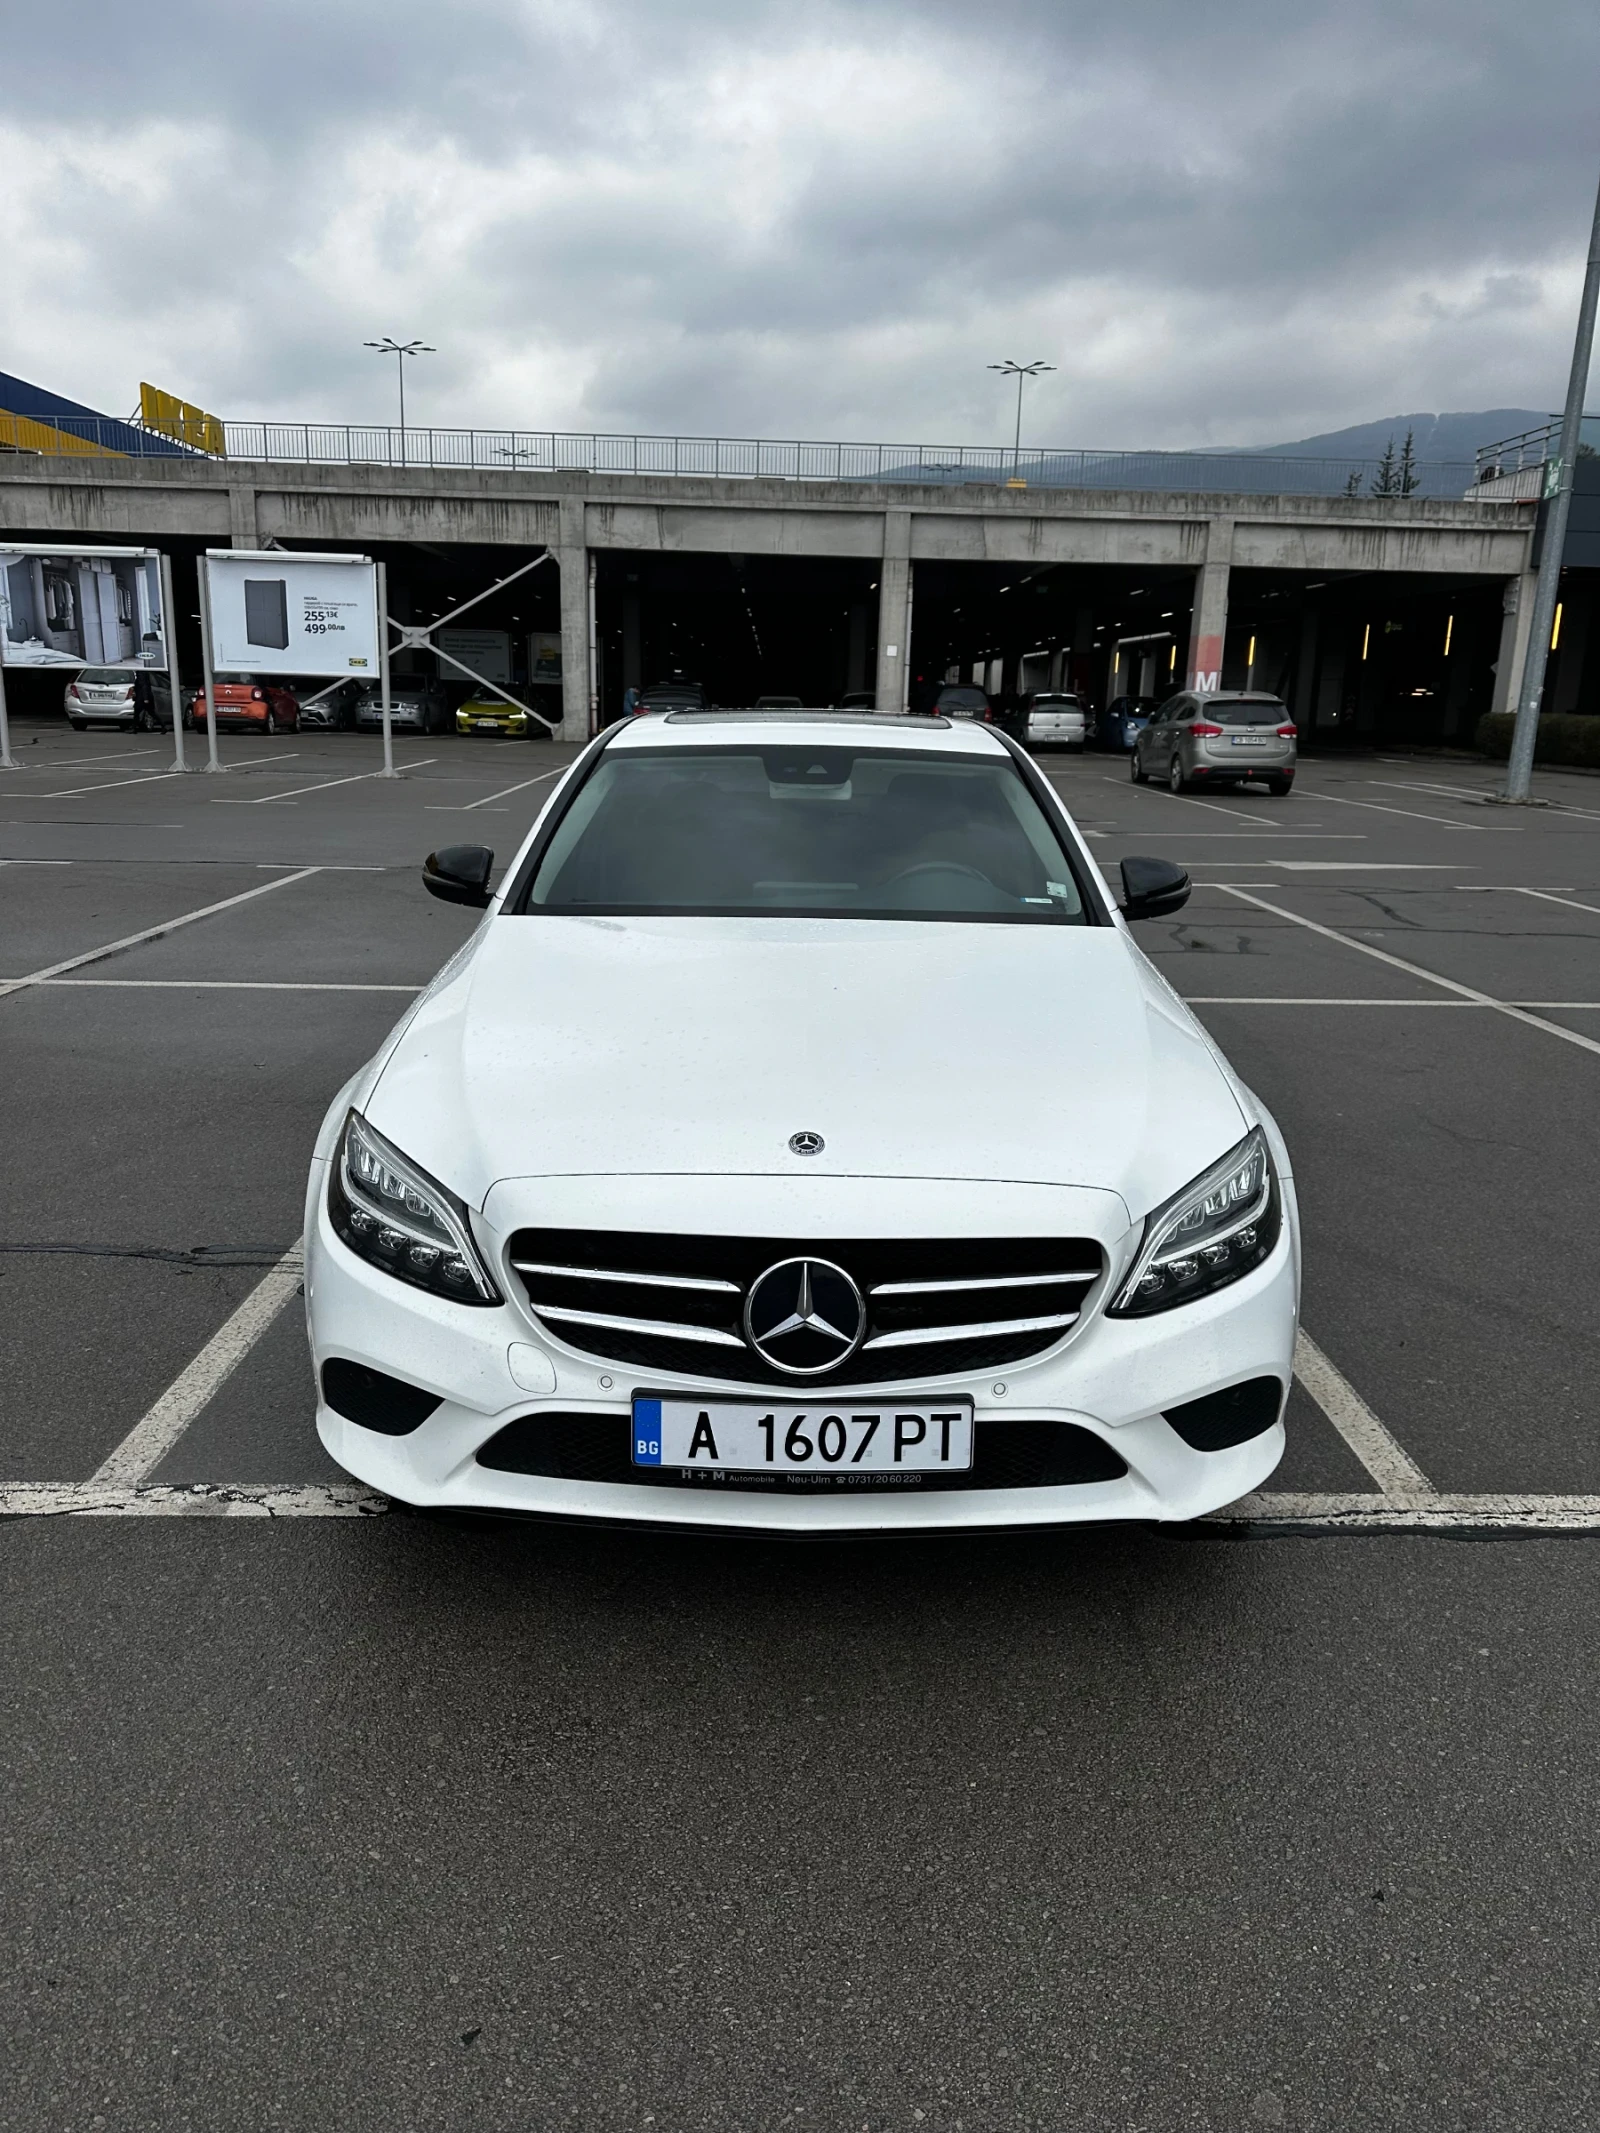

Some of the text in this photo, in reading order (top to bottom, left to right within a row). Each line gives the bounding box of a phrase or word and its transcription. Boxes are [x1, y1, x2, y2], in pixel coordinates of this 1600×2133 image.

[1196, 671, 1217, 691] M
[688, 1411, 962, 1463] A 1607 PT
[637, 1440, 659, 1455] BG
[681, 1469, 692, 1479] H
[713, 1471, 725, 1481] M
[728, 1475, 776, 1483] Automobile
[787, 1475, 831, 1484] Neu-Ulm
